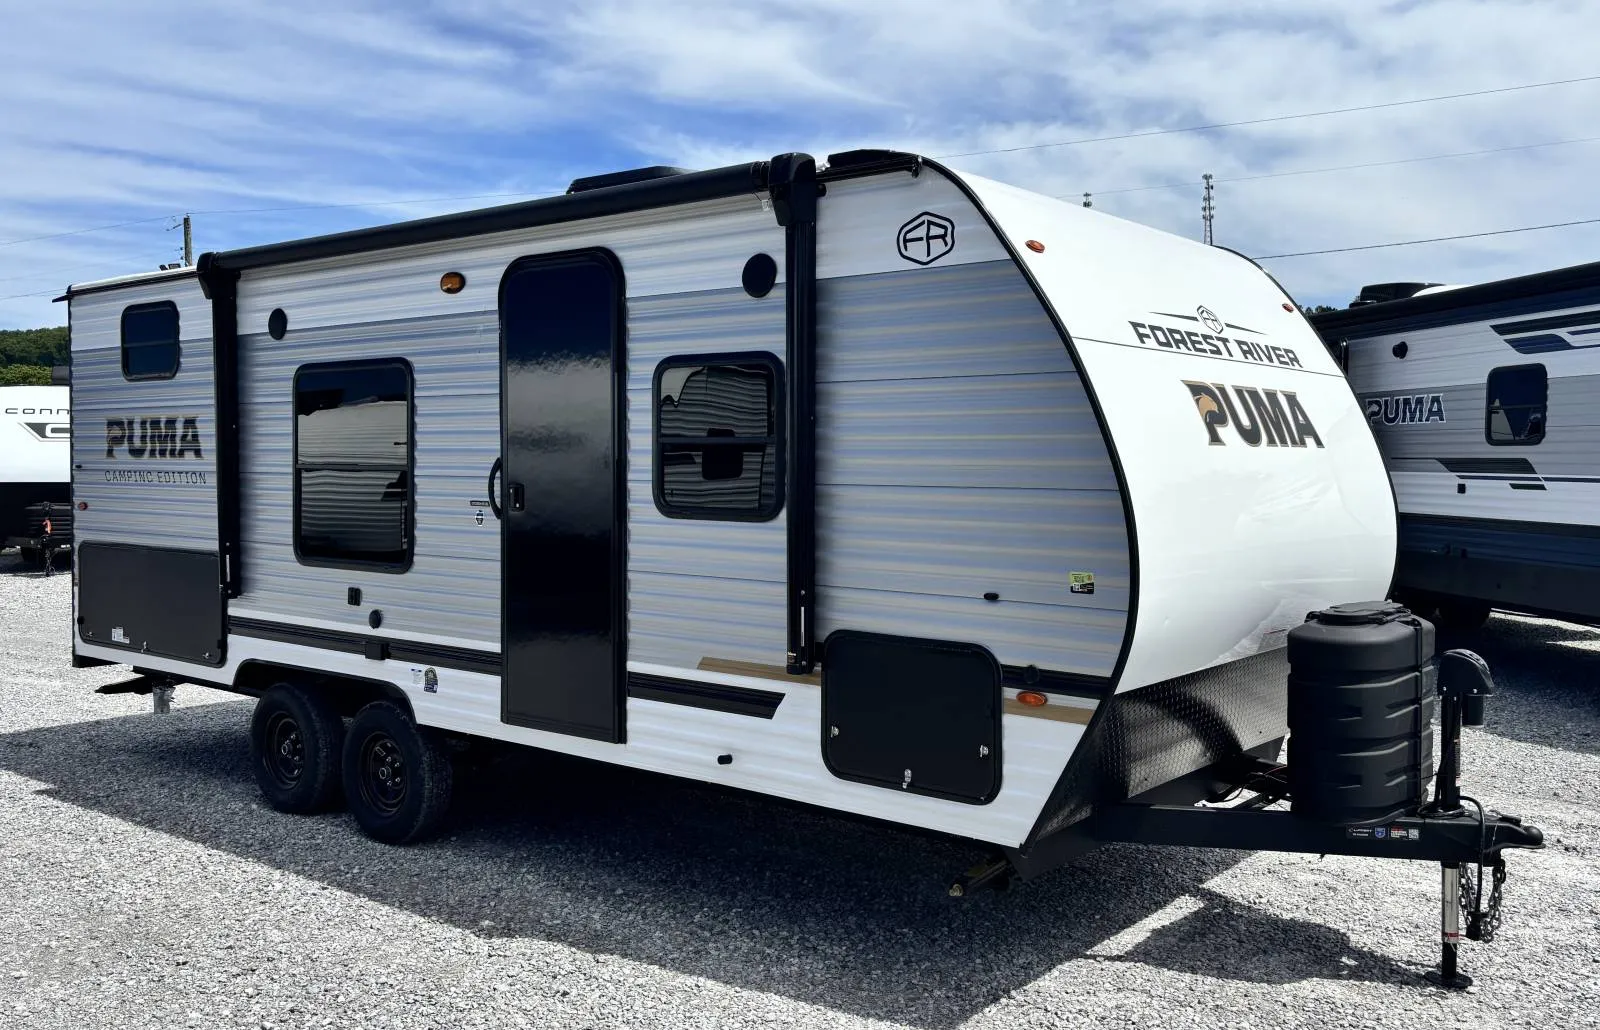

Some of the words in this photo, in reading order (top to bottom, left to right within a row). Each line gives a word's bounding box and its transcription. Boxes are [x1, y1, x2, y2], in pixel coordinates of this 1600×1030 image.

[1128, 320, 1233, 357] FOREST
[1234, 339, 1303, 368] RIVER
[1181, 379, 1325, 448] PUMA
[1366, 393, 1446, 425] PUMA
[105, 415, 204, 459] PUMA
[104, 470, 153, 483] CAMPING
[157, 471, 207, 484] EDITION
